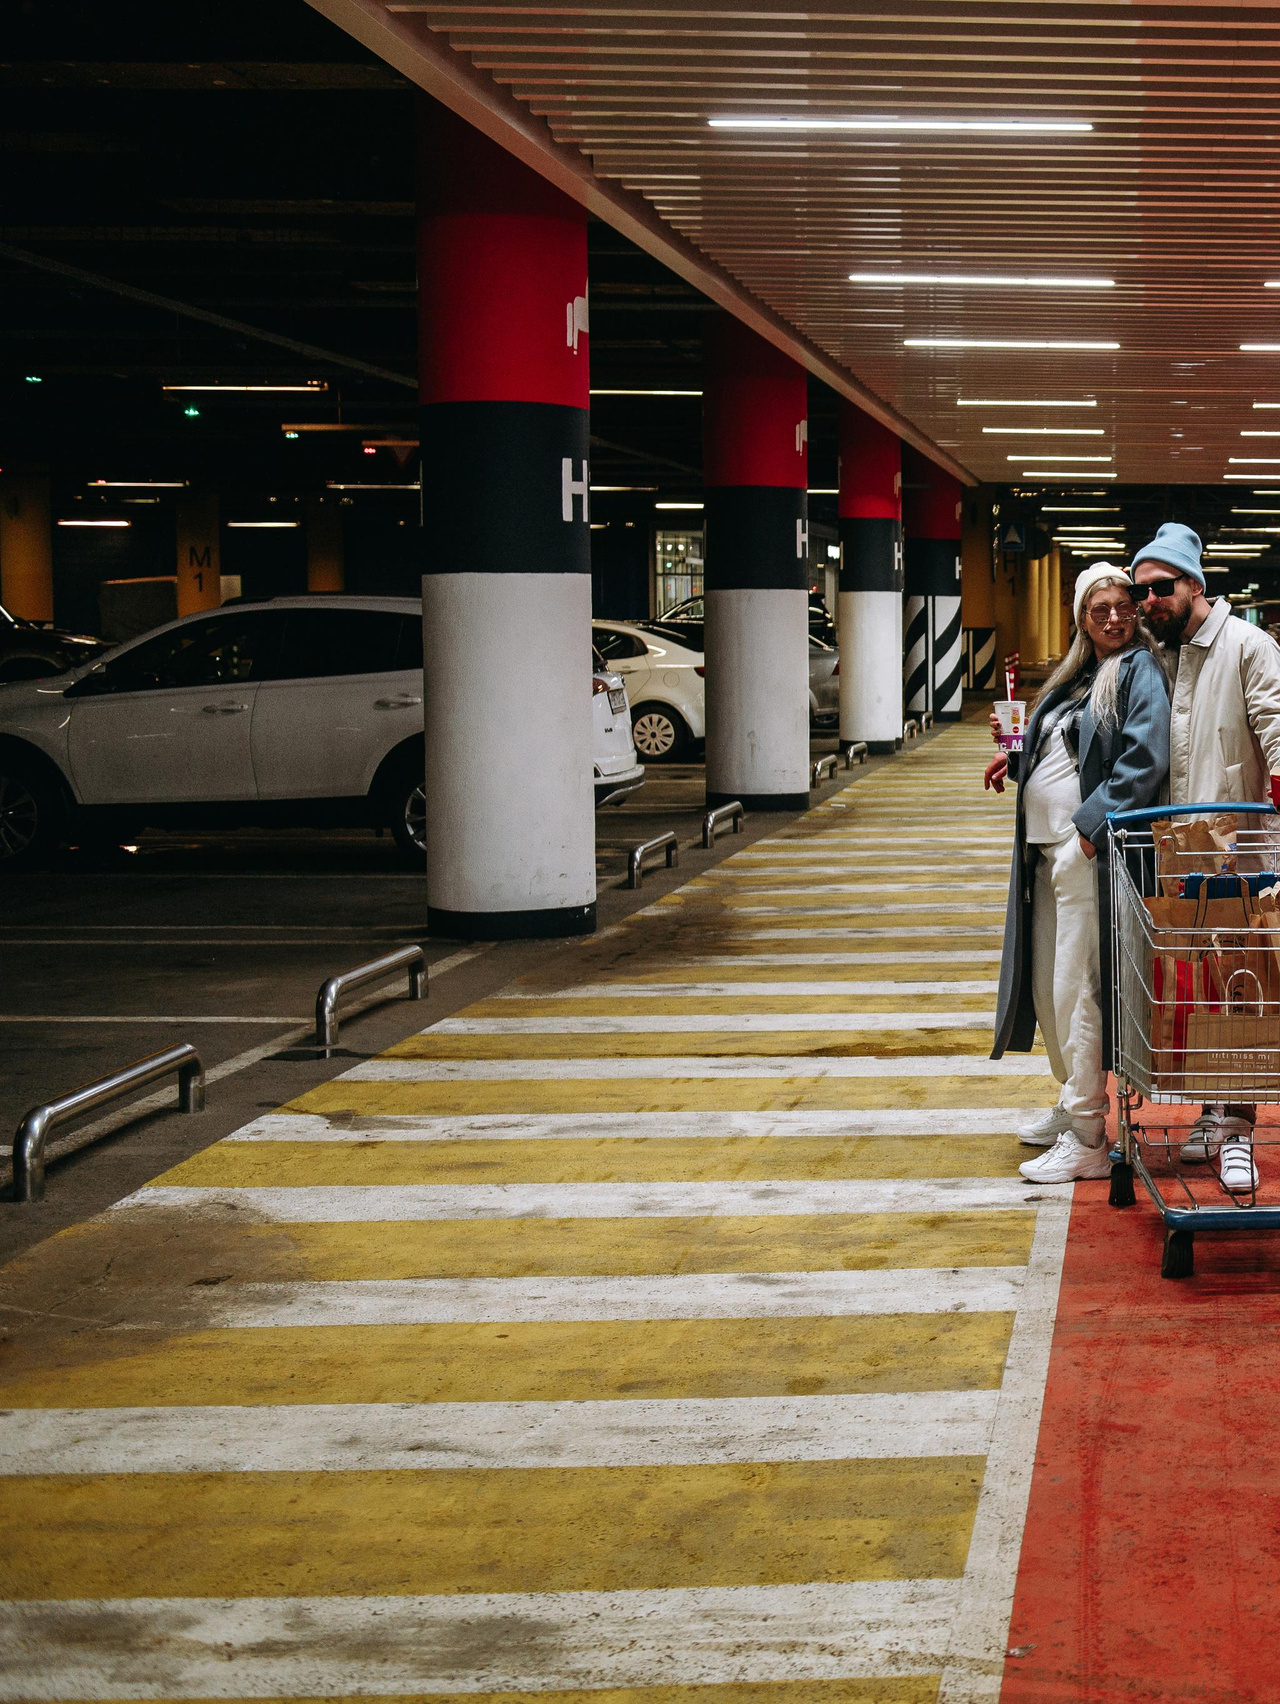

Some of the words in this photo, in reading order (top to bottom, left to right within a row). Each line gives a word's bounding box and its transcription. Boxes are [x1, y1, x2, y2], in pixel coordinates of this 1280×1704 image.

[190, 546, 211, 568] M
[194, 572, 203, 592] 1
[1008, 576, 1016, 597] 1
